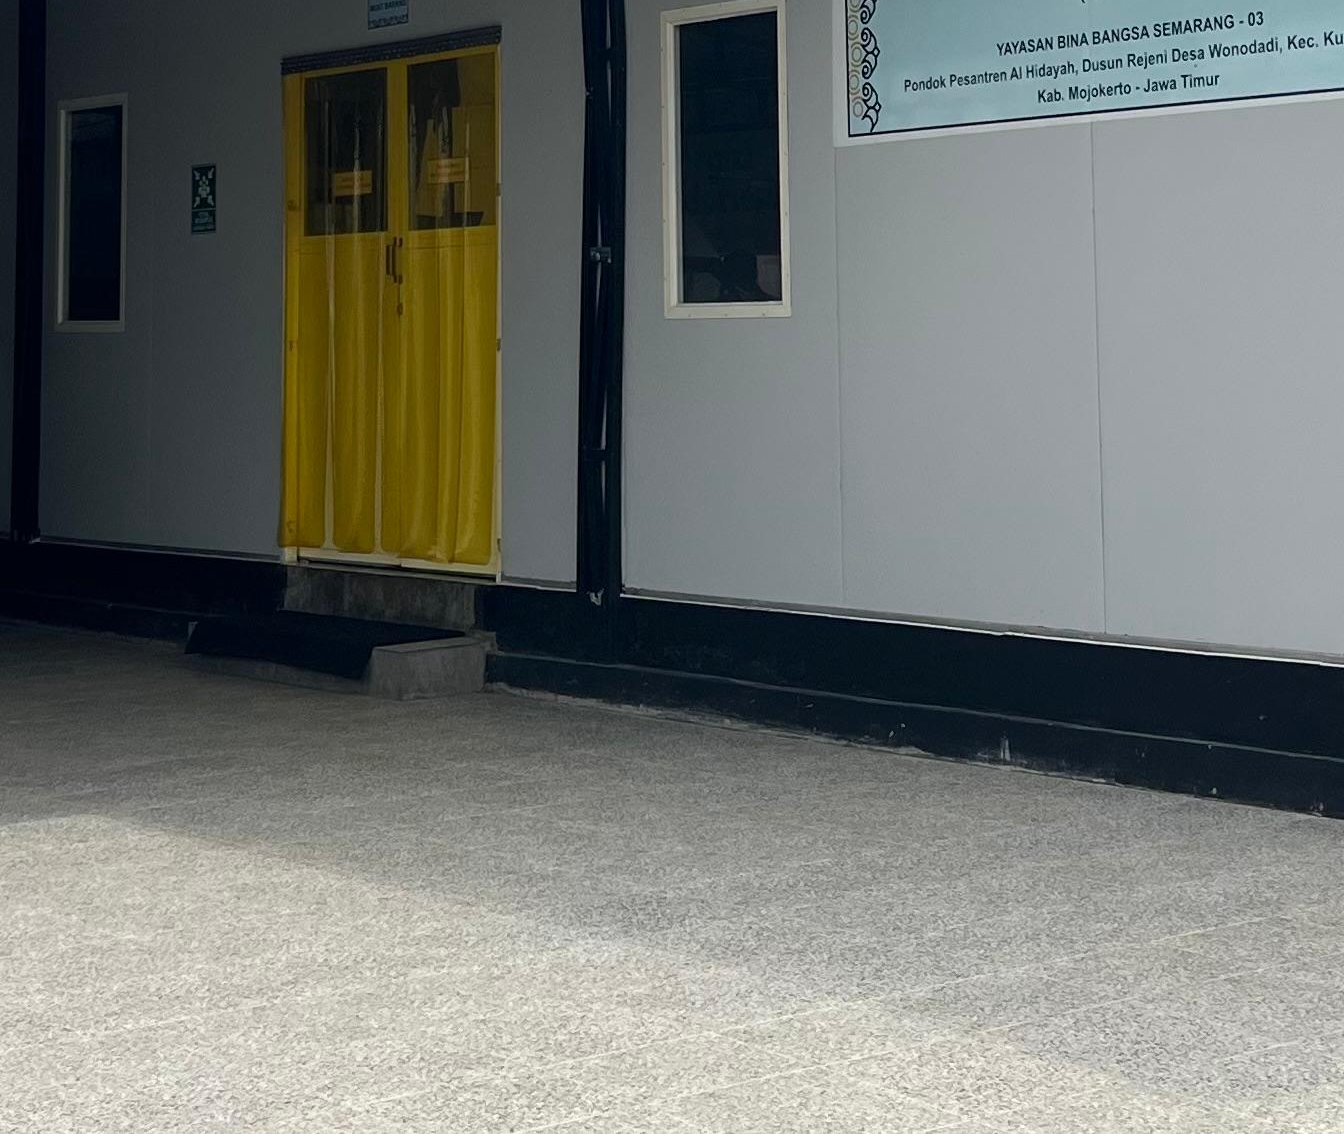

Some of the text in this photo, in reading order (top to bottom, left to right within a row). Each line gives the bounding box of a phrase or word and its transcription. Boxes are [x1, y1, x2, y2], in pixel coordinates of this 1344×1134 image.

[997, 36, 1054, 56] YAYASAN
[1057, 33, 1089, 50] BINA
[1092, 25, 1150, 46] BANGSA
[1153, 14, 1235, 38] SEMARANG
[1247, 11, 1264, 27] 03
[904, 75, 946, 93] Pondok
[949, 70, 1007, 88] Pesantren
[1010, 66, 1023, 80] Al
[1026, 61, 1078, 80] Hidayah,
[1082, 55, 1123, 73] Dusun
[1127, 49, 1168, 70] Rejeni
[1172, 47, 1205, 63] Desa
[1209, 37, 1283, 60] Wonodadi,
[1287, 34, 1319, 51] Kec.
[1037, 88, 1065, 103] Kab.
[1068, 82, 1132, 102] Mojokerto
[1143, 77, 1177, 93] Jawa
[1180, 73, 1220, 89] Timur
